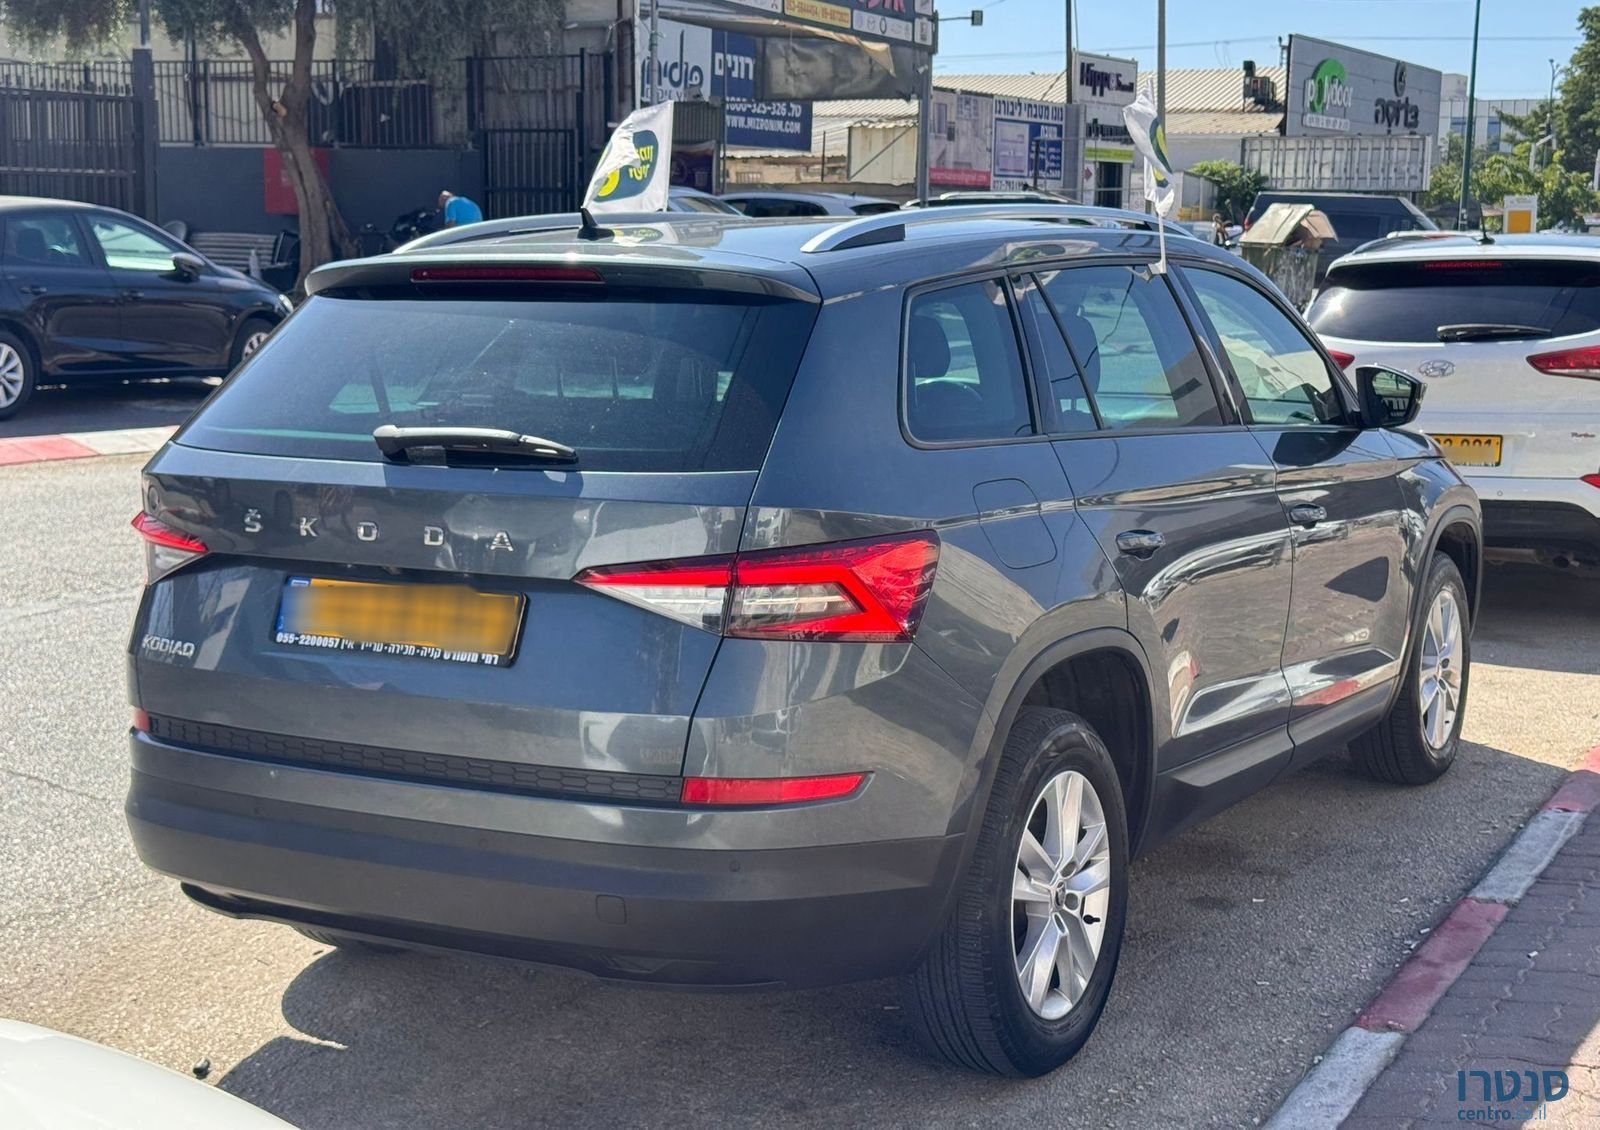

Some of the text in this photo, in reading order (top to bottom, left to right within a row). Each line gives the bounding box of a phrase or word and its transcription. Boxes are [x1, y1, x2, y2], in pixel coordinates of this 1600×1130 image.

[1024, 101, 1049, 120] מטבחי
[142, 634, 195, 659] KODIAQ
[276, 632, 340, 648] 055-2200057
[481, 653, 499, 665] רמי
